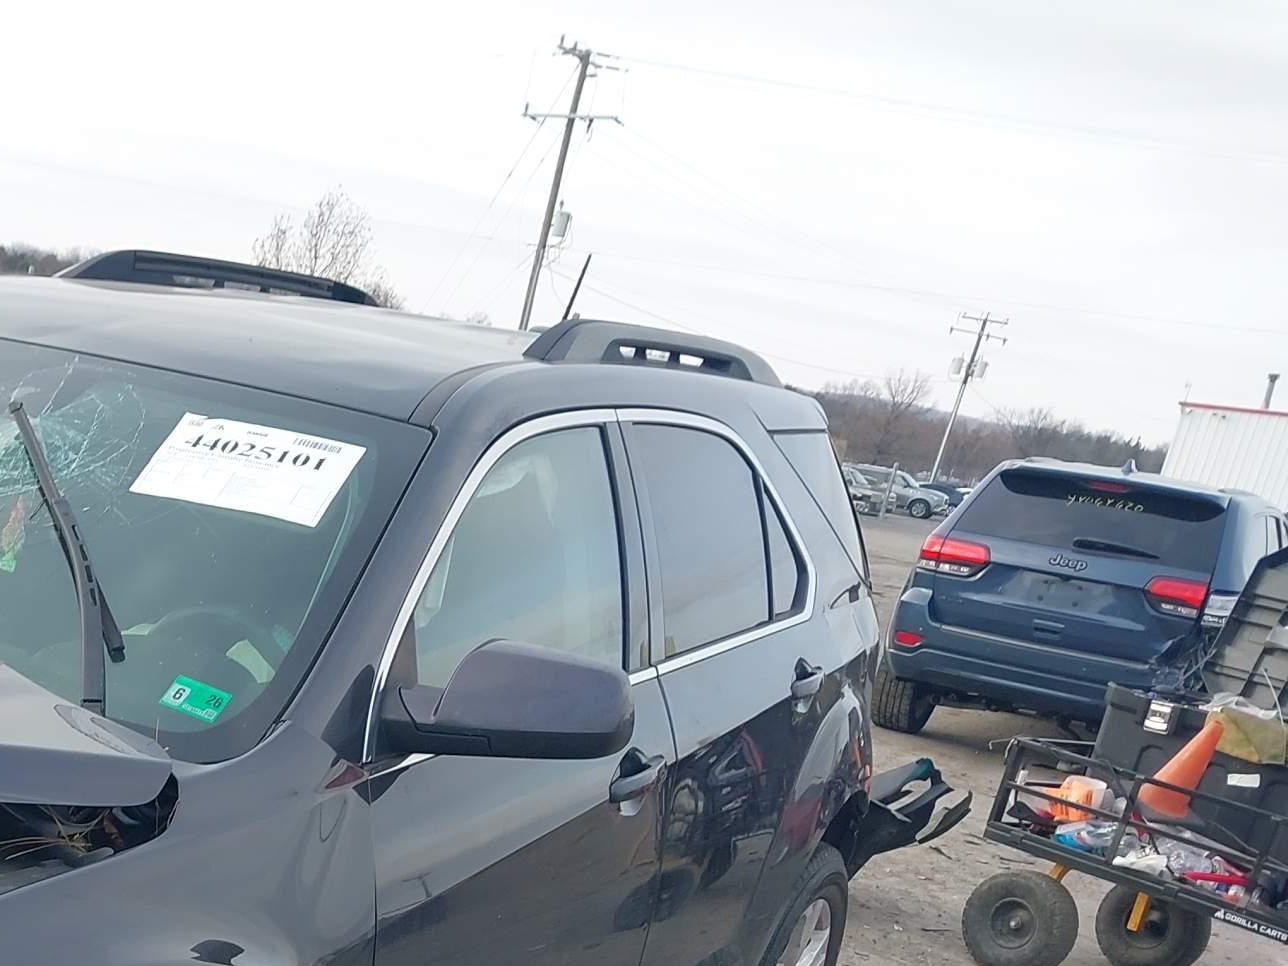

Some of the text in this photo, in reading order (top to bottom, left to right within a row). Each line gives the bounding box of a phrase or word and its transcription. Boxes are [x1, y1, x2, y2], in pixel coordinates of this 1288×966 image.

[185, 434, 326, 470] 44025101
[1049, 553, 1088, 572] Jeep
[172, 687, 223, 708] 6 26
[1225, 912, 1258, 931] GORILLA
